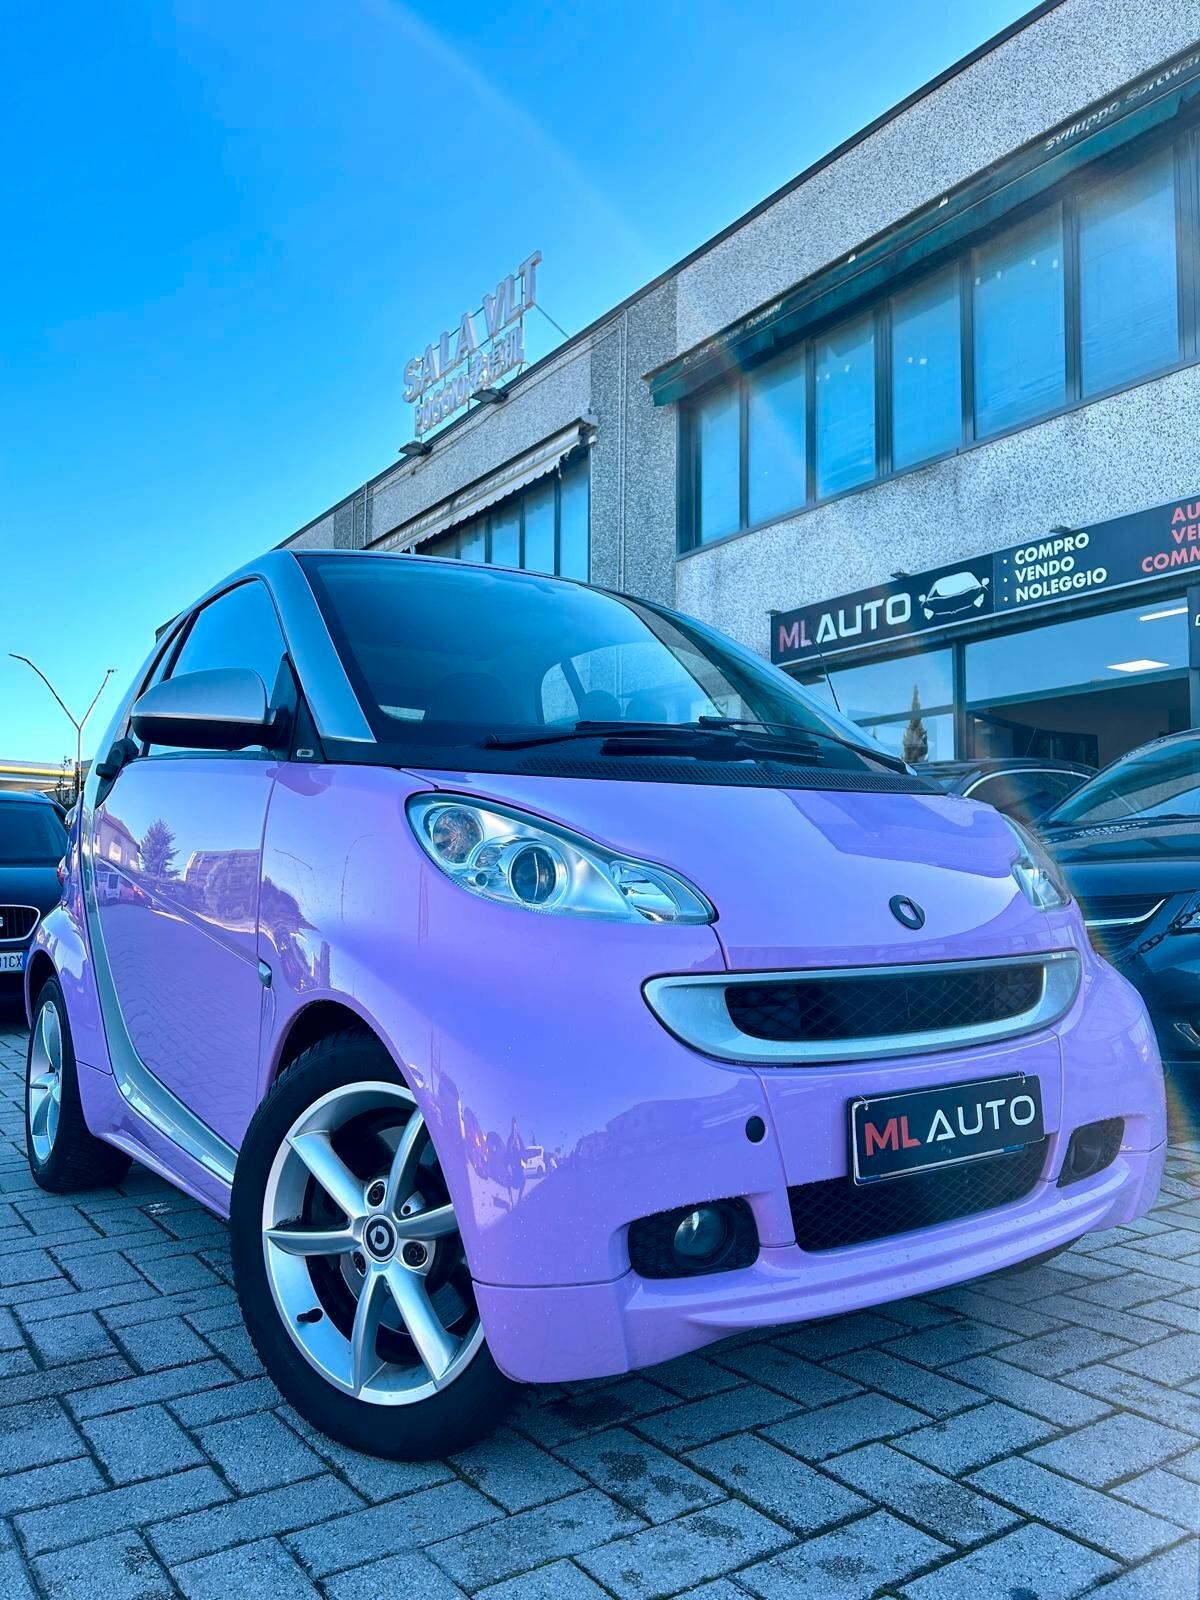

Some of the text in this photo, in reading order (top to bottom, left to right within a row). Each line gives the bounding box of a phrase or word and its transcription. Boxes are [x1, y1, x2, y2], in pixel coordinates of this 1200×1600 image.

[402, 311, 479, 404] SALA
[482, 249, 543, 338] VLT
[1014, 533, 1090, 566] COMPRO
[1171, 523, 1200, 544] VE
[1014, 556, 1075, 584] VENDO
[1015, 567, 1107, 603] NOLEGGIO
[816, 593, 911, 644] AUTO
[0, 955, 22, 968] 1CX
[864, 1095, 1036, 1157] ML AUTO
